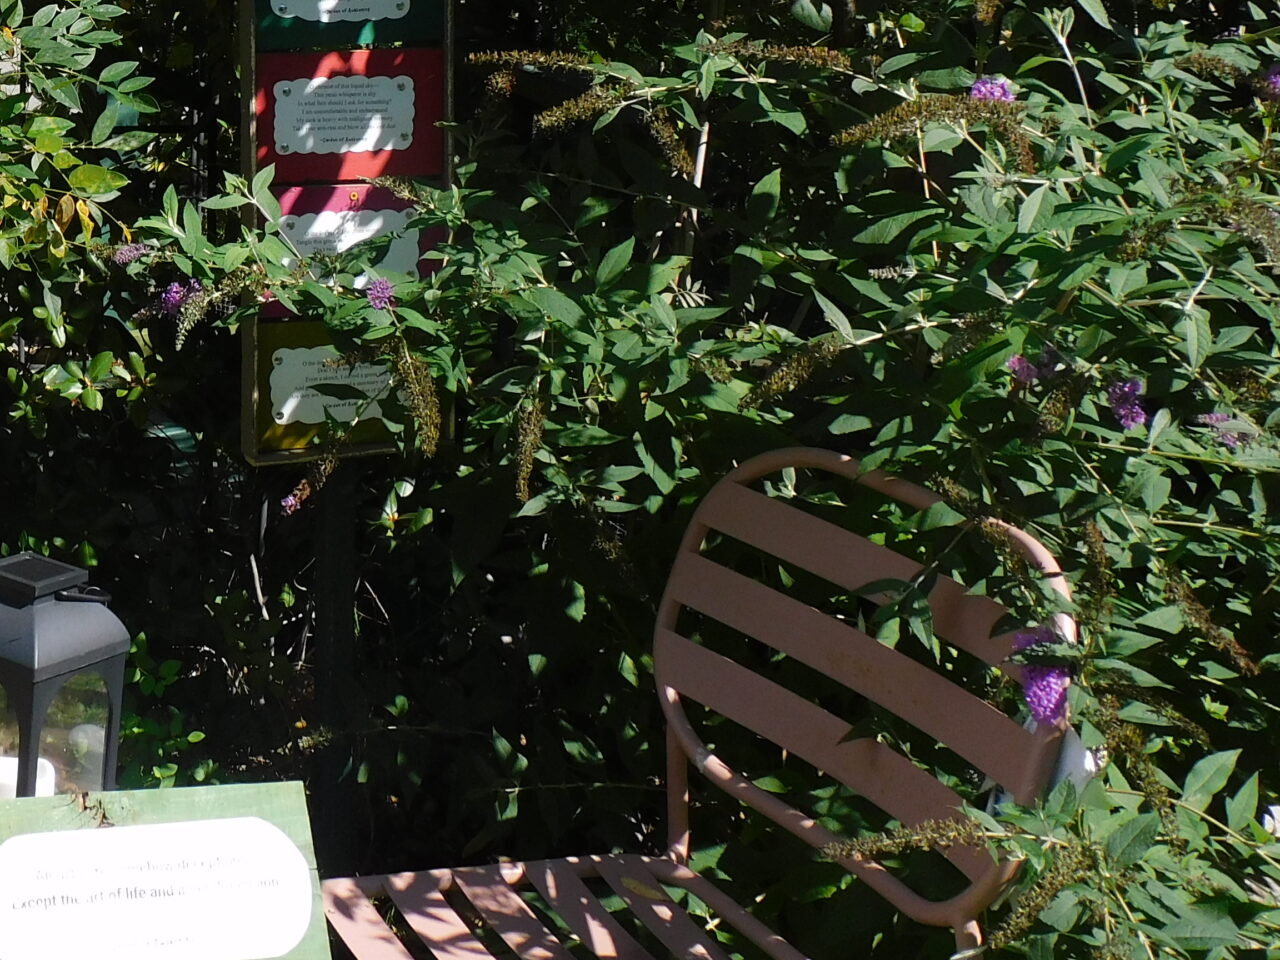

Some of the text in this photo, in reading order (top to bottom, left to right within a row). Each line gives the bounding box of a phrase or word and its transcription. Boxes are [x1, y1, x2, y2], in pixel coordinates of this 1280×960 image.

[108, 888, 122, 900] of
[125, 886, 146, 900] life
[150, 884, 174, 899] and
